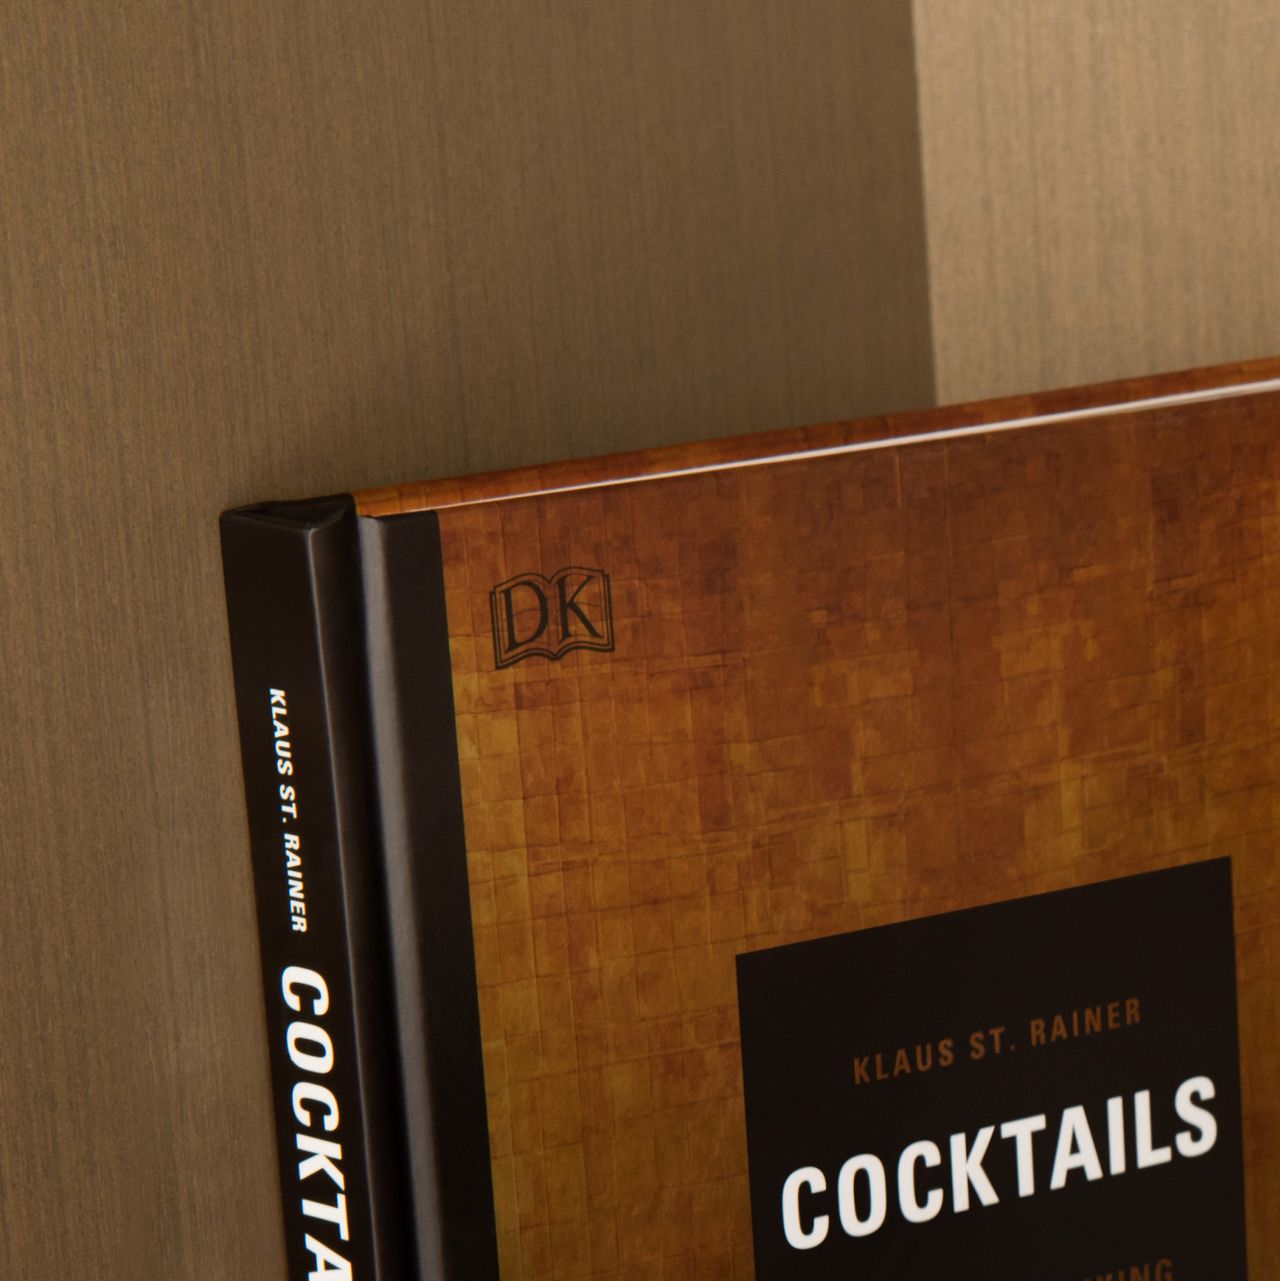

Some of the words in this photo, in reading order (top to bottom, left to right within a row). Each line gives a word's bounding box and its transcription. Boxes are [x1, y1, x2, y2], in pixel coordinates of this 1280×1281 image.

[502, 573, 605, 654] DK
[269, 688, 294, 776] KLAUS
[279, 784, 298, 823] ST.
[284, 833, 307, 933] RAINER
[853, 1037, 955, 1085] KLAUS
[969, 1026, 1016, 1060] ST.
[1029, 997, 1141, 1047] RAINER
[781, 1075, 1219, 1250] COCKTAILS
